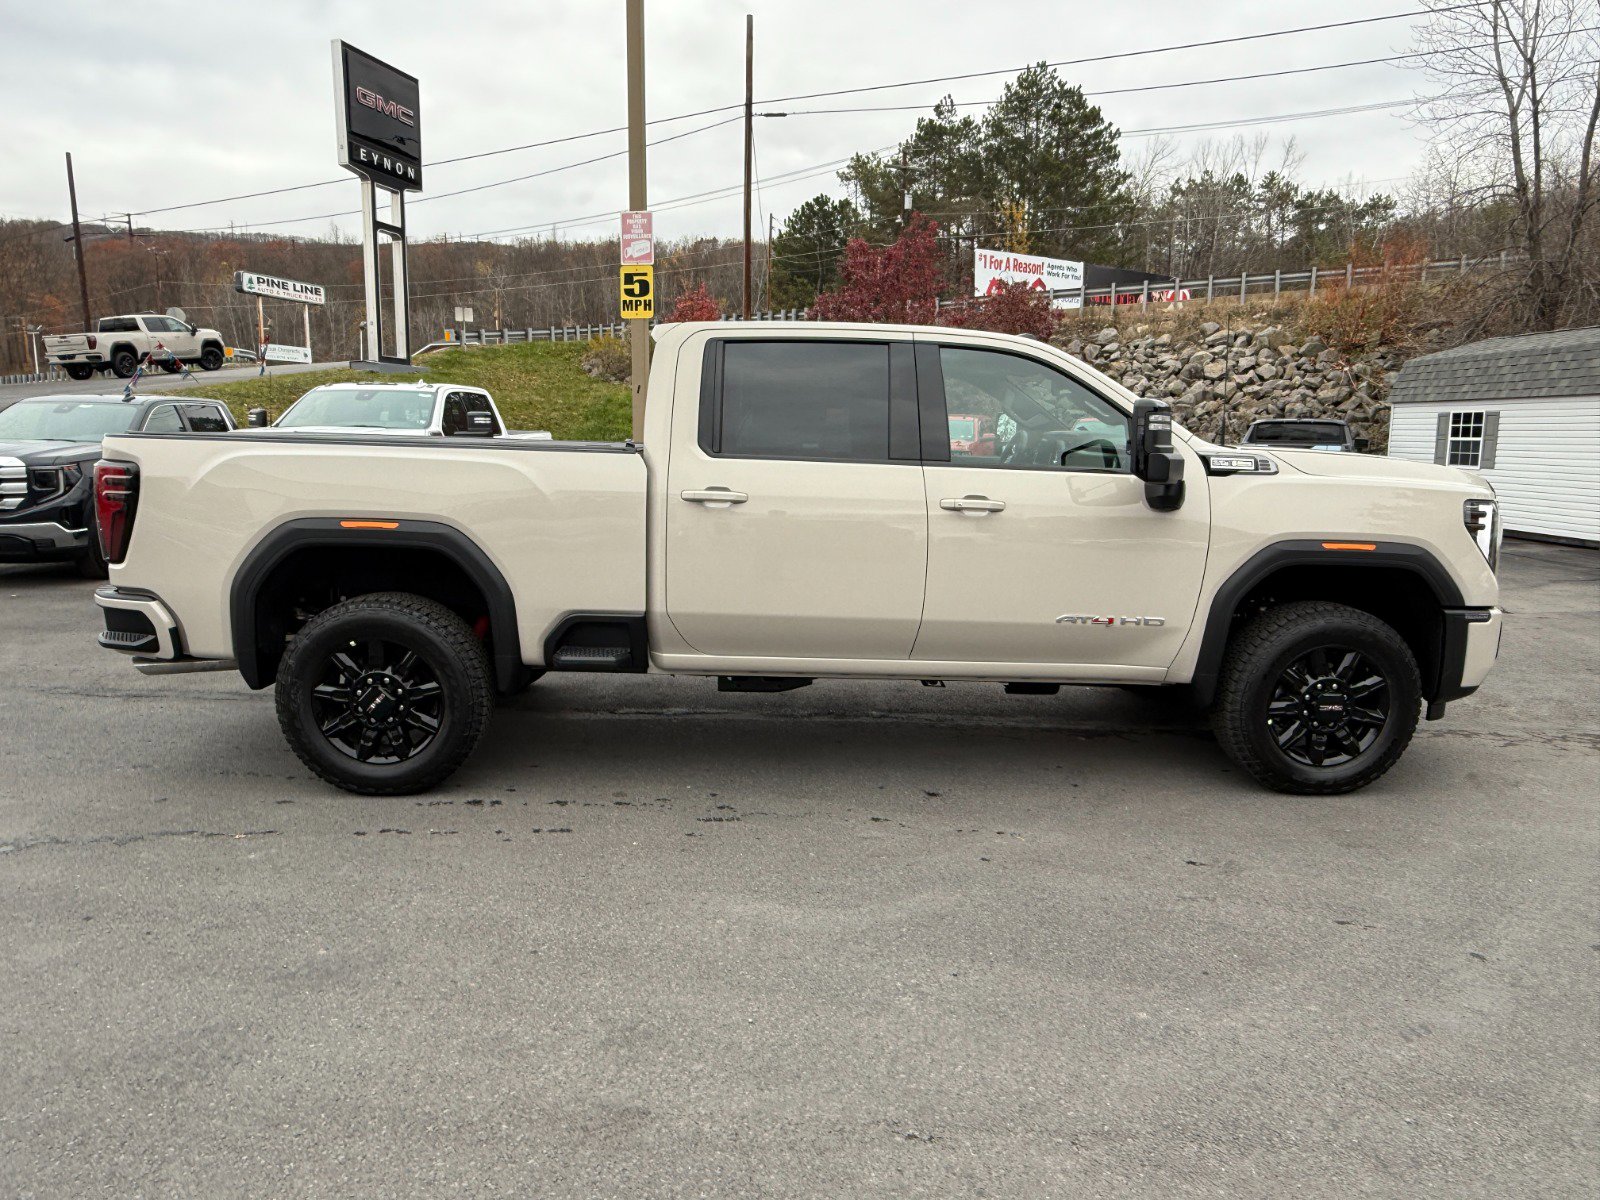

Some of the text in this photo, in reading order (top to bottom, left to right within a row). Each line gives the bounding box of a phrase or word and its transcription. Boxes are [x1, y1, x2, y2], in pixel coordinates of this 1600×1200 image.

[357, 87, 414, 127] GMC
[360, 148, 415, 180] EYNON
[989, 255, 1003, 270] For
[1004, 257, 1011, 272] A
[1012, 258, 1045, 275] Reason!
[1047, 263, 1078, 273] Agents Who
[257, 277, 322, 296] PINE LINE
[624, 273, 650, 297] 5
[622, 299, 652, 311] MPH
[1056, 614, 1166, 627] AT4 HD
